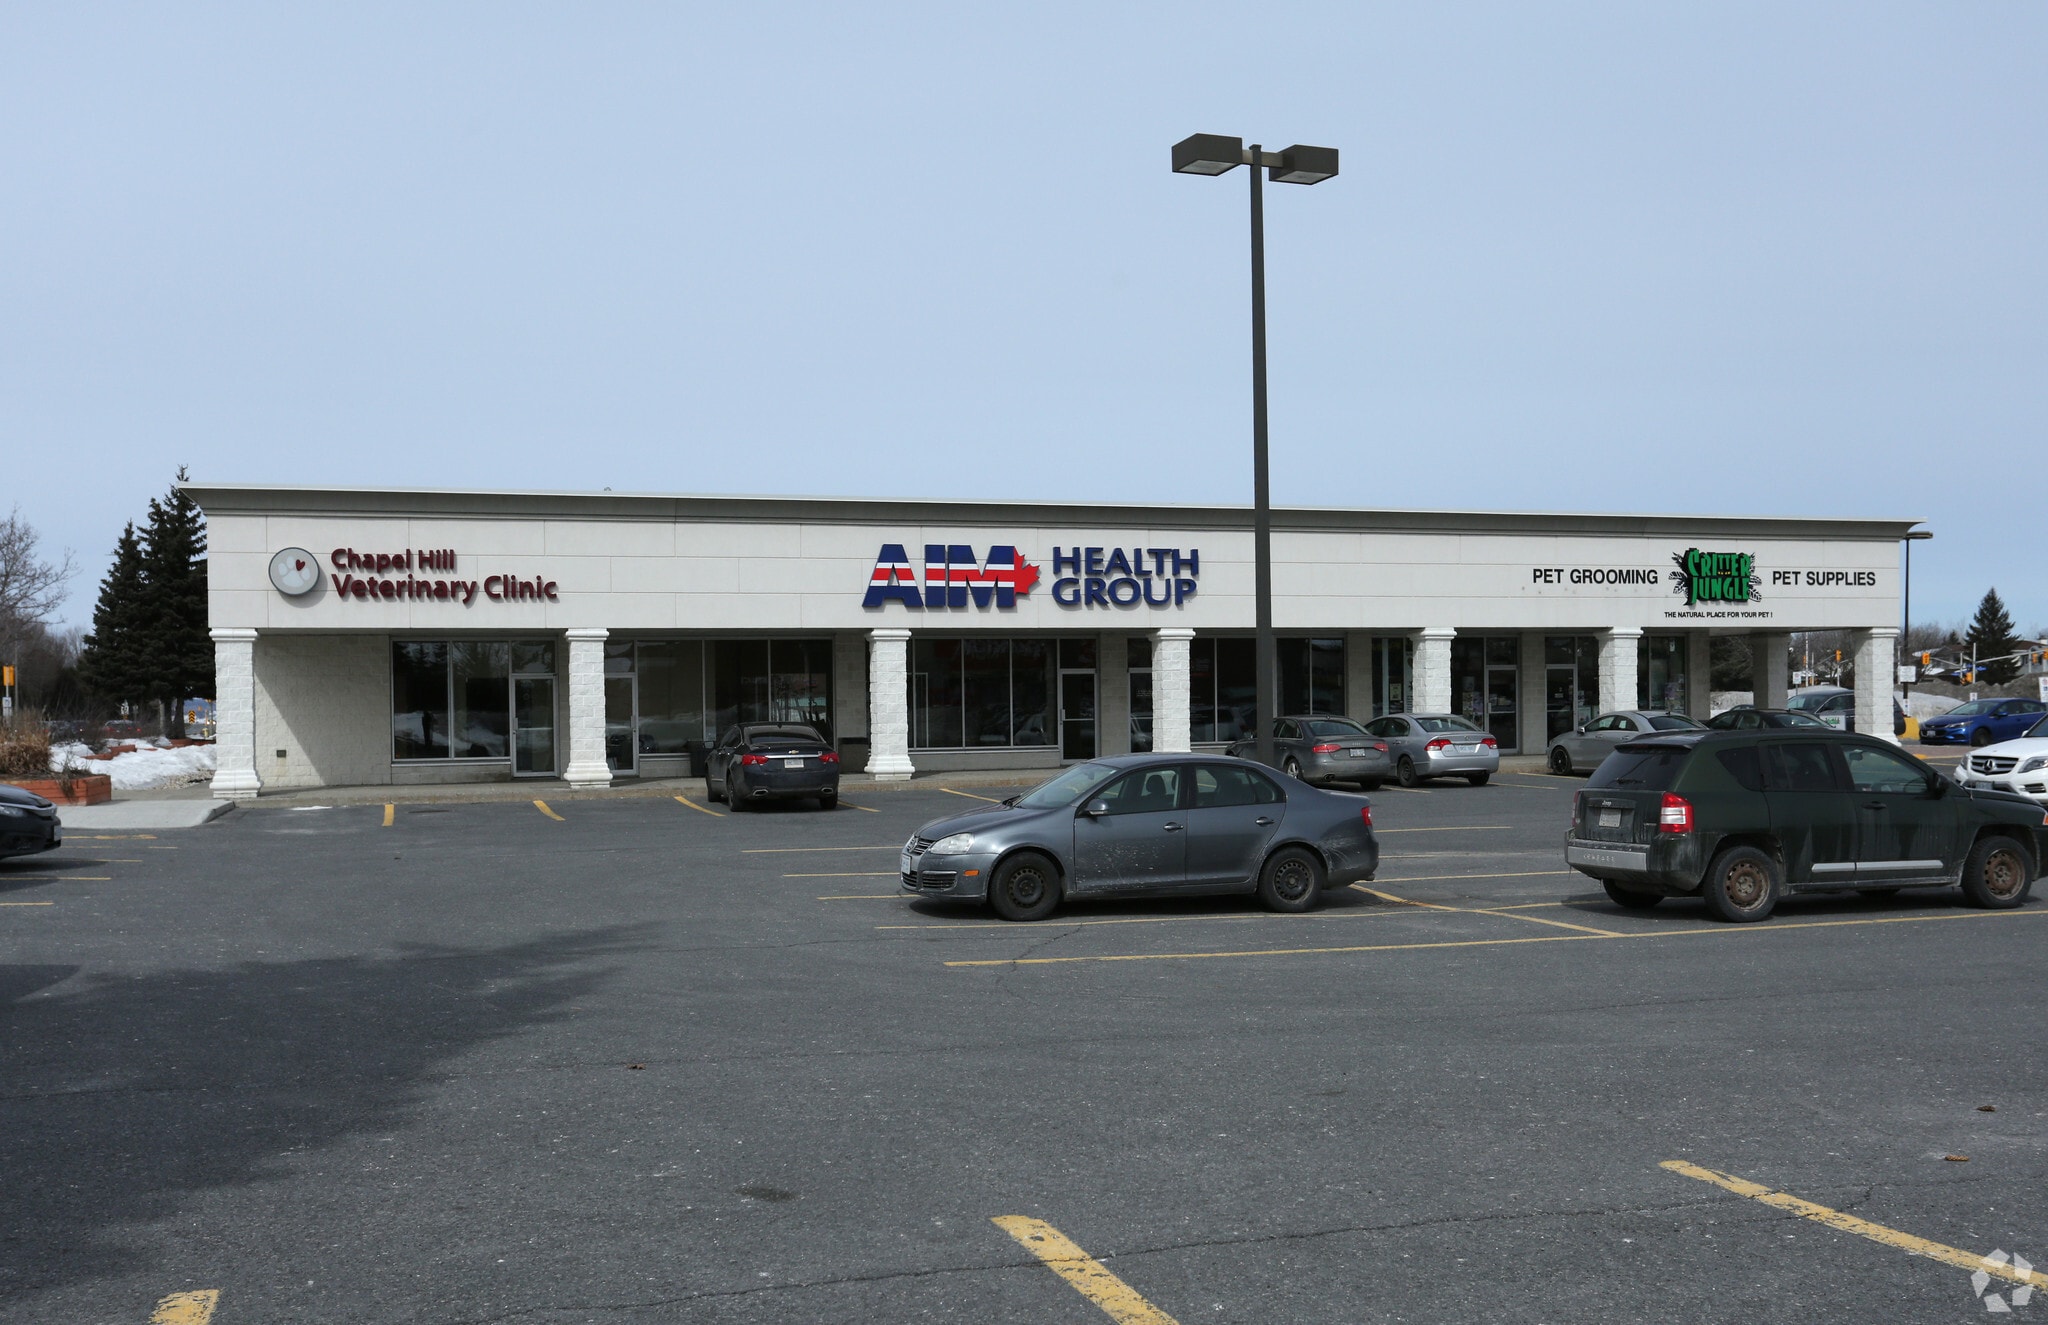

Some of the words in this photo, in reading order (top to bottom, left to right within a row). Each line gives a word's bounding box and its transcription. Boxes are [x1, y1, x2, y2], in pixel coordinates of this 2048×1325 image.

[331, 548, 411, 574] Chapel
[418, 549, 455, 569] Hill
[1052, 546, 1200, 576] HEALTH
[1687, 549, 1751, 577] CRITTER
[331, 574, 477, 605] Veterinary
[484, 575, 558, 599] Clinic
[861, 543, 1015, 608] AIM
[1533, 568, 1564, 584] PET
[1569, 567, 1658, 585] GROOMING
[1772, 570, 1801, 586] PET
[1806, 571, 1876, 587] SUPPLIES
[1051, 577, 1197, 606] GROUP
[1691, 576, 1751, 604] JUNGLE
